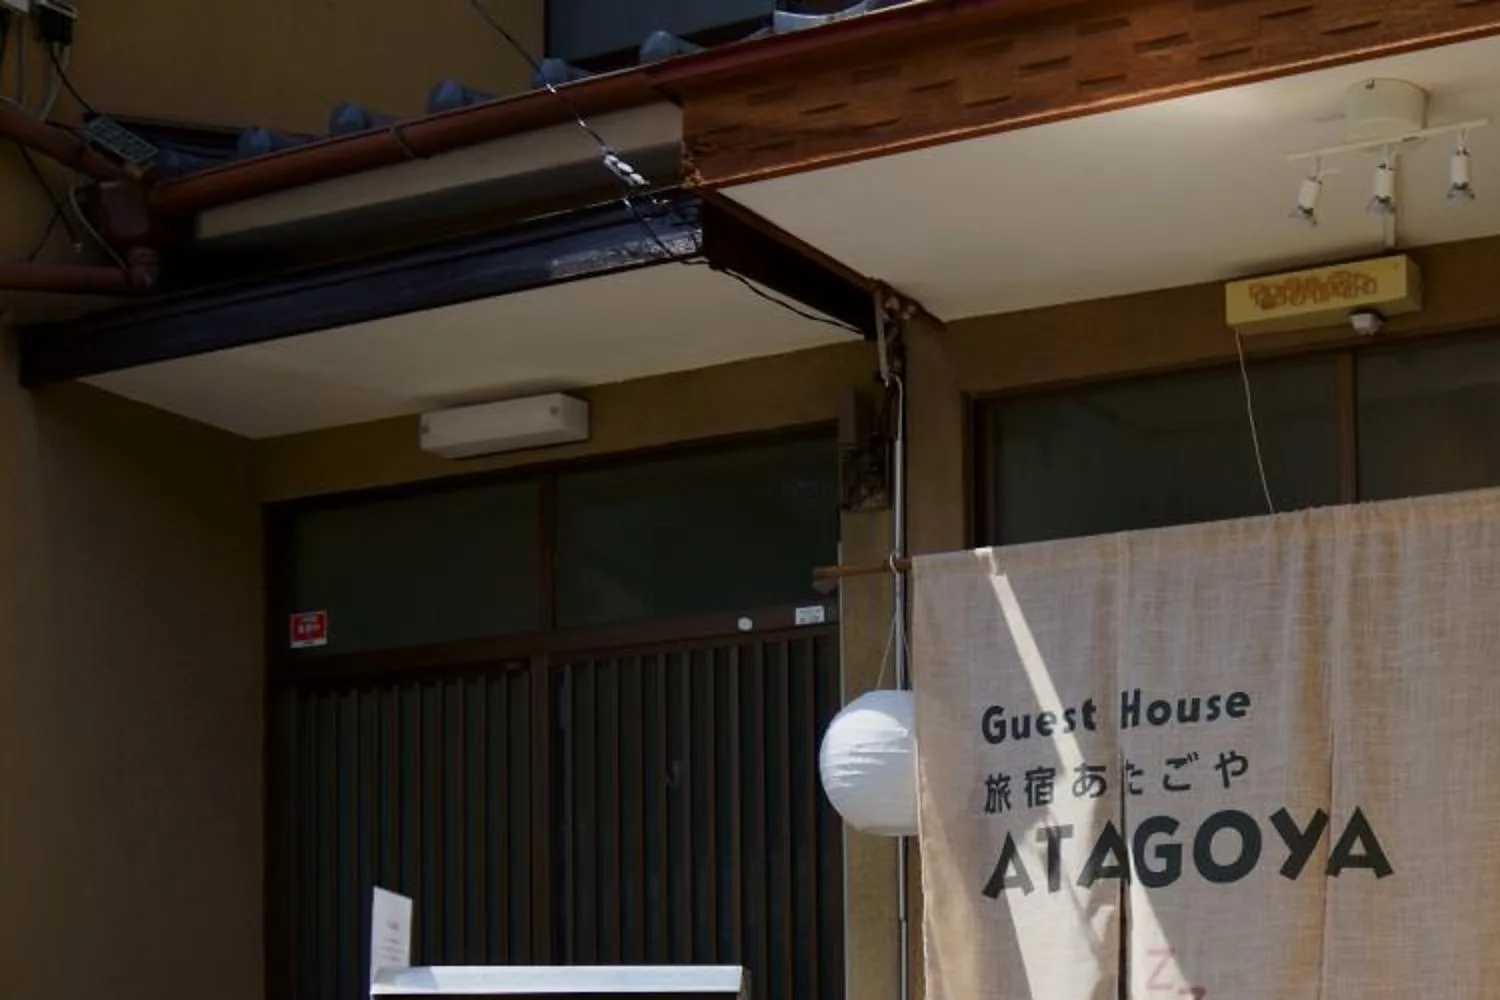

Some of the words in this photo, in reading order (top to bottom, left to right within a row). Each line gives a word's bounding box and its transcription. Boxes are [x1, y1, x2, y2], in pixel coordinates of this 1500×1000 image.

[981, 697, 1097, 745] Guest
[1120, 688, 1251, 730] House
[983, 750, 1249, 814] 旅宿あたごや
[981, 805, 1393, 899] ATAGOYA
